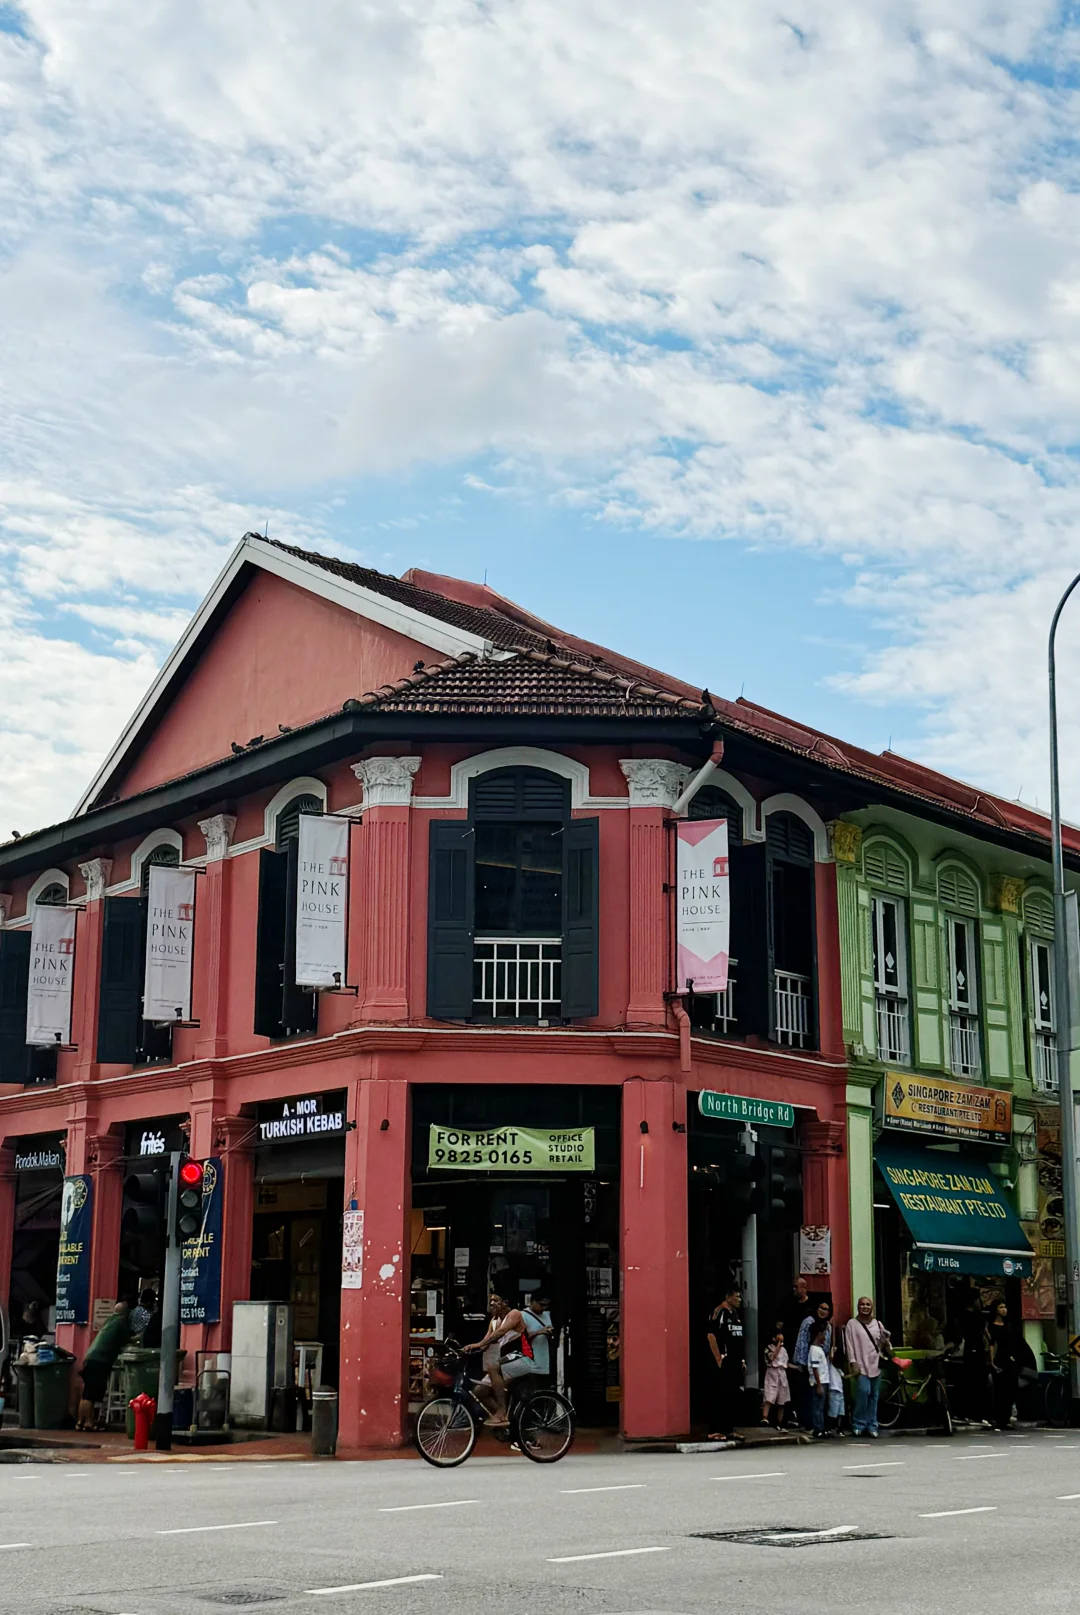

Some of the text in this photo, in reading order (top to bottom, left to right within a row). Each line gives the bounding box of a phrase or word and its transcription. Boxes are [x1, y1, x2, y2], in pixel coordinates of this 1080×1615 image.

[303, 862, 324, 873] THE
[682, 869, 705, 879] THE
[302, 880, 339, 896] PINK
[682, 885, 720, 900] PINK
[153, 908, 173, 918] THE
[302, 901, 339, 914] HOUSE
[682, 905, 720, 916] HOUSE
[152, 924, 187, 939] PINK
[35, 943, 54, 952] THE
[151, 944, 186, 955] HOUSE
[34, 958, 67, 971] PINK
[33, 976, 67, 985] HOUSE
[908, 1084, 954, 1103] SINGAPORE
[956, 1092, 974, 1106] ZAM
[974, 1095, 992, 1109] ZAM
[707, 1095, 789, 1121] North Bridge Rd
[918, 1103, 982, 1122] RESTAURANT PTE LTD
[260, 1113, 342, 1140] TURKISH KEBAB
[437, 1132, 518, 1145] FOR RENT
[549, 1134, 583, 1143] OFFICE
[548, 1144, 584, 1152] STUDIO
[435, 1149, 532, 1164] 9825 0165
[549, 1155, 583, 1163] RETAIL
[887, 1167, 995, 1194] SINGAPORE ZAM ZAM
[900, 1193, 1007, 1218] RESTAURANT PTE LTD
[938, 1257, 960, 1268] YLH Gas
